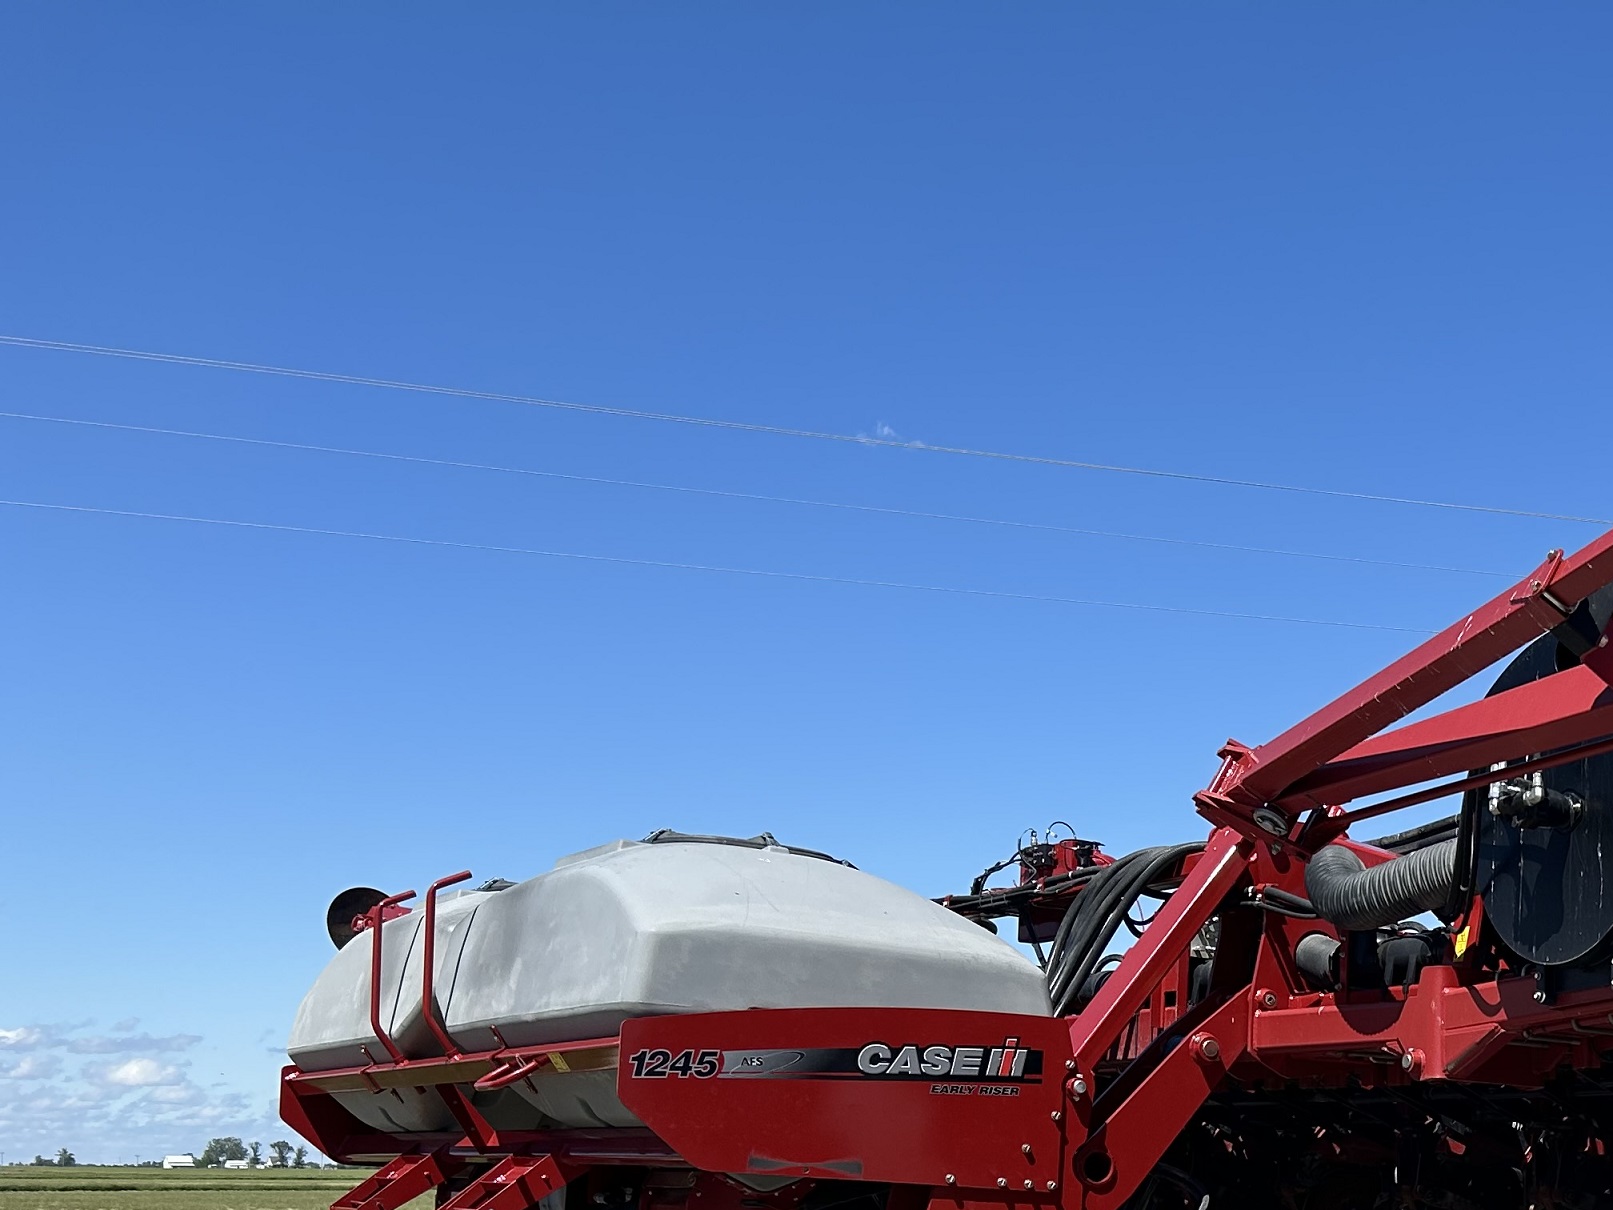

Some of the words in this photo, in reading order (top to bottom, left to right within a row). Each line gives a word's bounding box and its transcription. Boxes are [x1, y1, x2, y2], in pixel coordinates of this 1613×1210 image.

[629, 1049, 720, 1079] 1245
[857, 1043, 983, 1076] CASE
[930, 1084, 976, 1095] EARLY
[978, 1086, 1020, 1096] RISER
